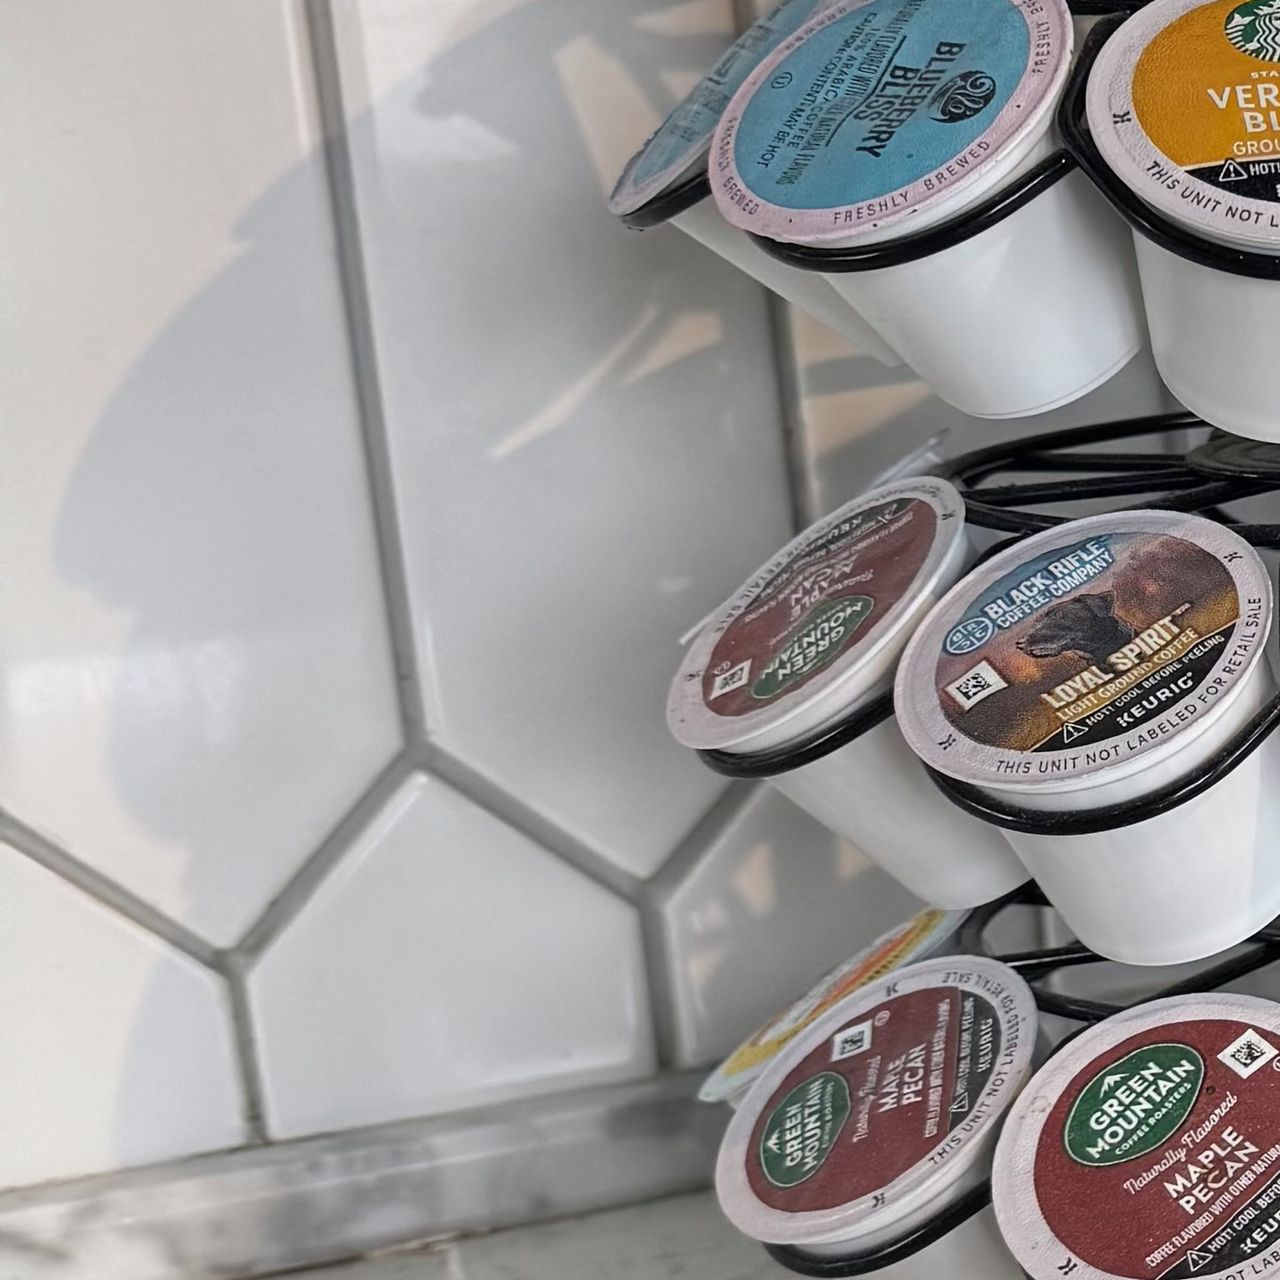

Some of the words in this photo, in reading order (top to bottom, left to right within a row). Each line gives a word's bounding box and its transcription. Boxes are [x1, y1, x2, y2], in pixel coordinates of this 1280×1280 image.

[1031, 18, 1051, 75] FRESHLY
[853, 65, 923, 123] BLISS
[856, 41, 967, 159] BLUEBERRY
[756, 143, 780, 169] HOT
[833, 190, 911, 224] FRESHLY
[922, 139, 992, 191] BREWED
[1146, 159, 1179, 192] THIS
[1180, 185, 1223, 214] UNIT
[1224, 206, 1262, 225] NOT
[985, 568, 1047, 620] BLACK
[1050, 538, 1108, 579] RIFLE
[996, 591, 1049, 630] COFFEE
[1051, 551, 1116, 599] COMPANY
[777, 624, 846, 681] GREEN
[996, 759, 1033, 775] THIS
[1038, 756, 1078, 774] UNIT
[1085, 743, 1122, 766] NOT
[1125, 703, 1198, 752] LABELED
[1198, 678, 1229, 704] FOR
[1224, 629, 1256, 678] RETAIL
[1248, 596, 1264, 629] SALE
[1040, 663, 1114, 709] LOYAL
[1055, 691, 1098, 722] LIGHT
[1097, 658, 1153, 704] GROUND
[1152, 627, 1199, 666] COFFEE
[1116, 684, 1144, 708] COOL
[1143, 660, 1181, 689] BEFORE
[1181, 633, 1226, 668] PEELING
[1116, 672, 1195, 727] KEURIG
[902, 1043, 928, 1107] PECAN
[977, 1017, 994, 1074] KEURIG
[801, 1077, 827, 1172] MOUNTAIN
[1085, 1058, 1196, 1160] MOUNTAIN
[1090, 1061, 1166, 1131] GREEN
[1114, 1120, 1151, 1156] COFFEE
[1148, 1081, 1194, 1125] ROASTERS
[785, 1102, 804, 1168] GREEN
[928, 1135, 962, 1167] THIS
[1123, 1144, 1187, 1196] Naturally
[1184, 1090, 1239, 1156] Flavored
[1163, 1124, 1246, 1202] MAPLE
[1177, 1139, 1262, 1216] PECAN
[1146, 1236, 1178, 1269] COFFEE
[1173, 1210, 1216, 1248] FLAVORED
[1208, 1193, 1235, 1217] WITH
[1229, 1173, 1258, 1201] OTHER
[1208, 1226, 1237, 1252] HOT!
[1233, 1203, 1260, 1233] COOL
